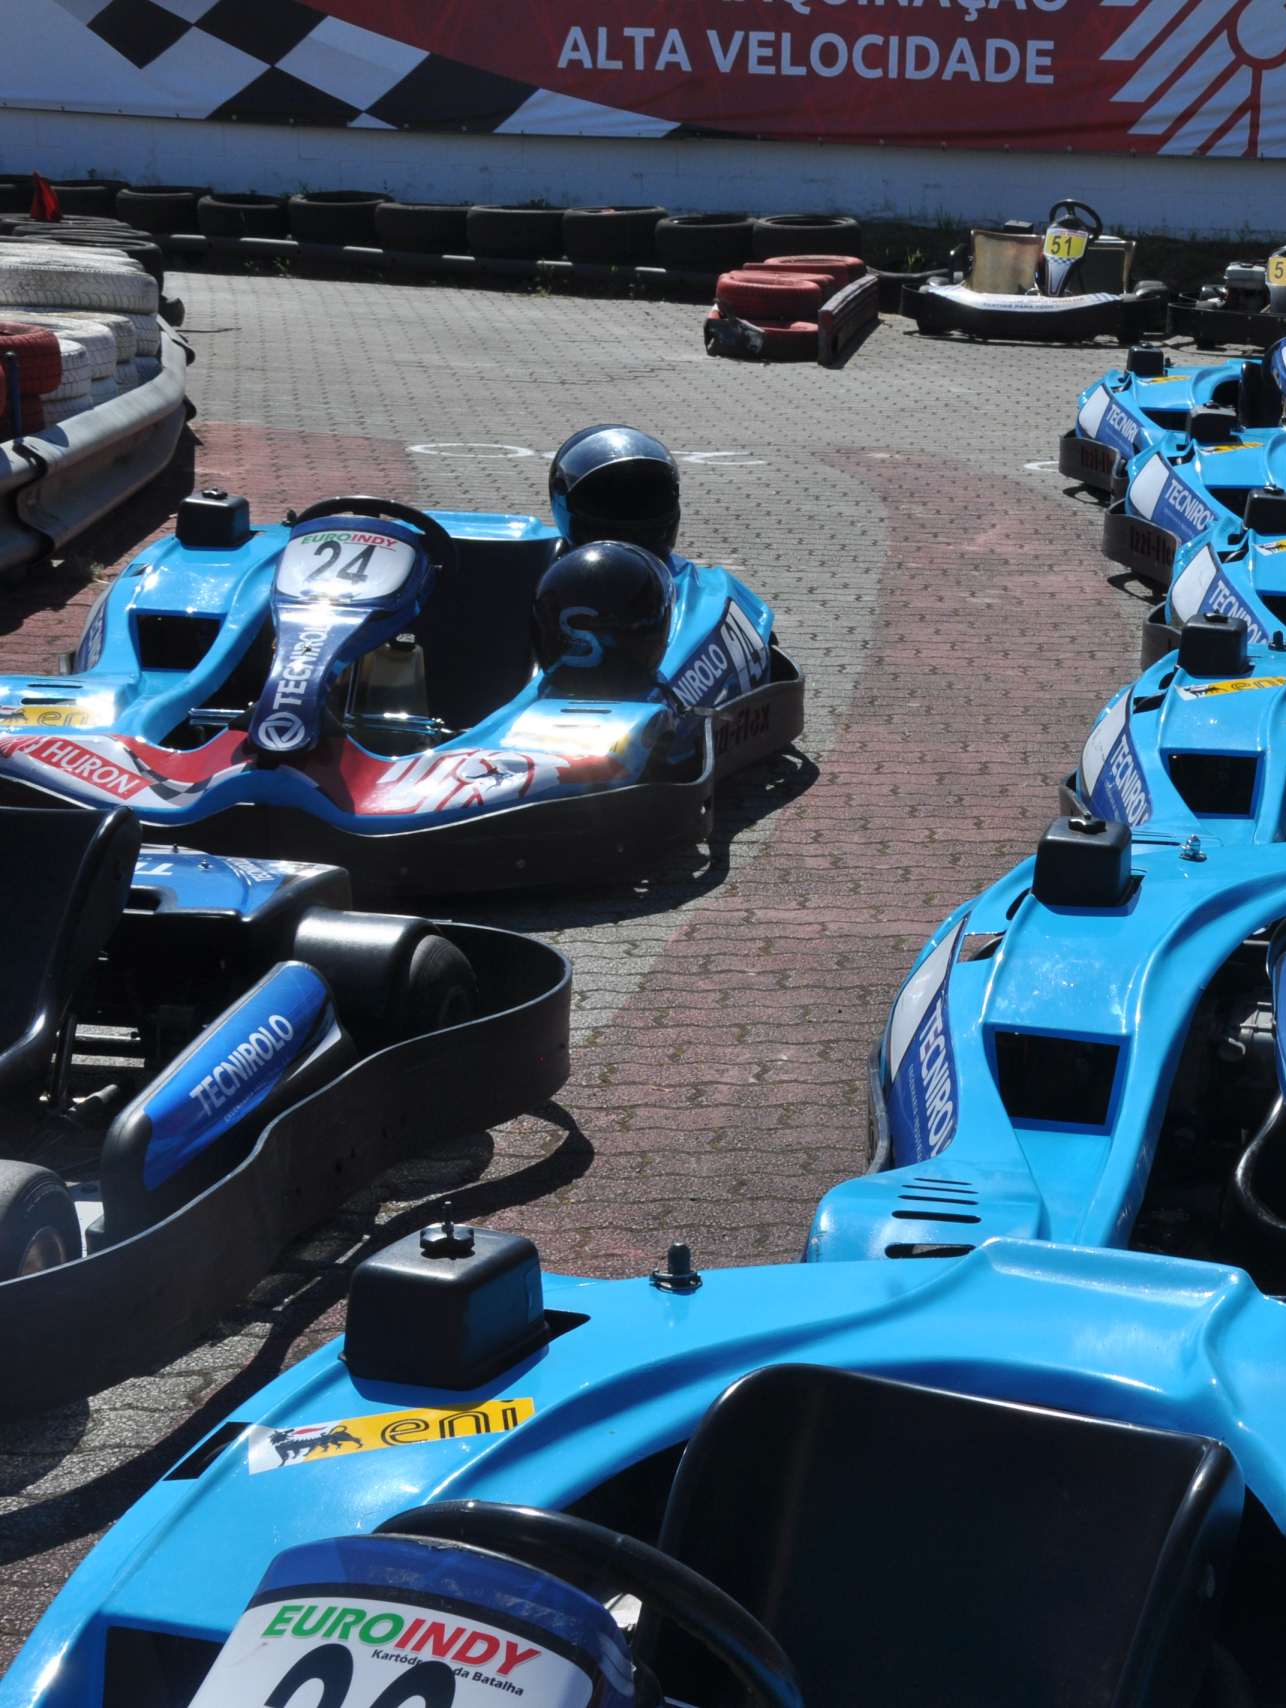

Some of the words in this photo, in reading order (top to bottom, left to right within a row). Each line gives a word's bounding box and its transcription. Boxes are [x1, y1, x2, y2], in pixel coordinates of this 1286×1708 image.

[557, 26, 692, 71] ALTA
[706, 29, 1055, 84] VELOCIDADE
[1050, 235, 1073, 256] 51
[302, 532, 397, 548] EUROINDY
[306, 539, 378, 584] 24
[559, 606, 604, 668] S
[44, 741, 140, 794] HURON
[189, 1014, 294, 1117] TECNIROLO
[919, 998, 954, 1159] TECNIROL
[380, 1400, 520, 1447] eni
[260, 1604, 542, 1677] EUROINDY
[471, 1671, 525, 1697] Batalha
